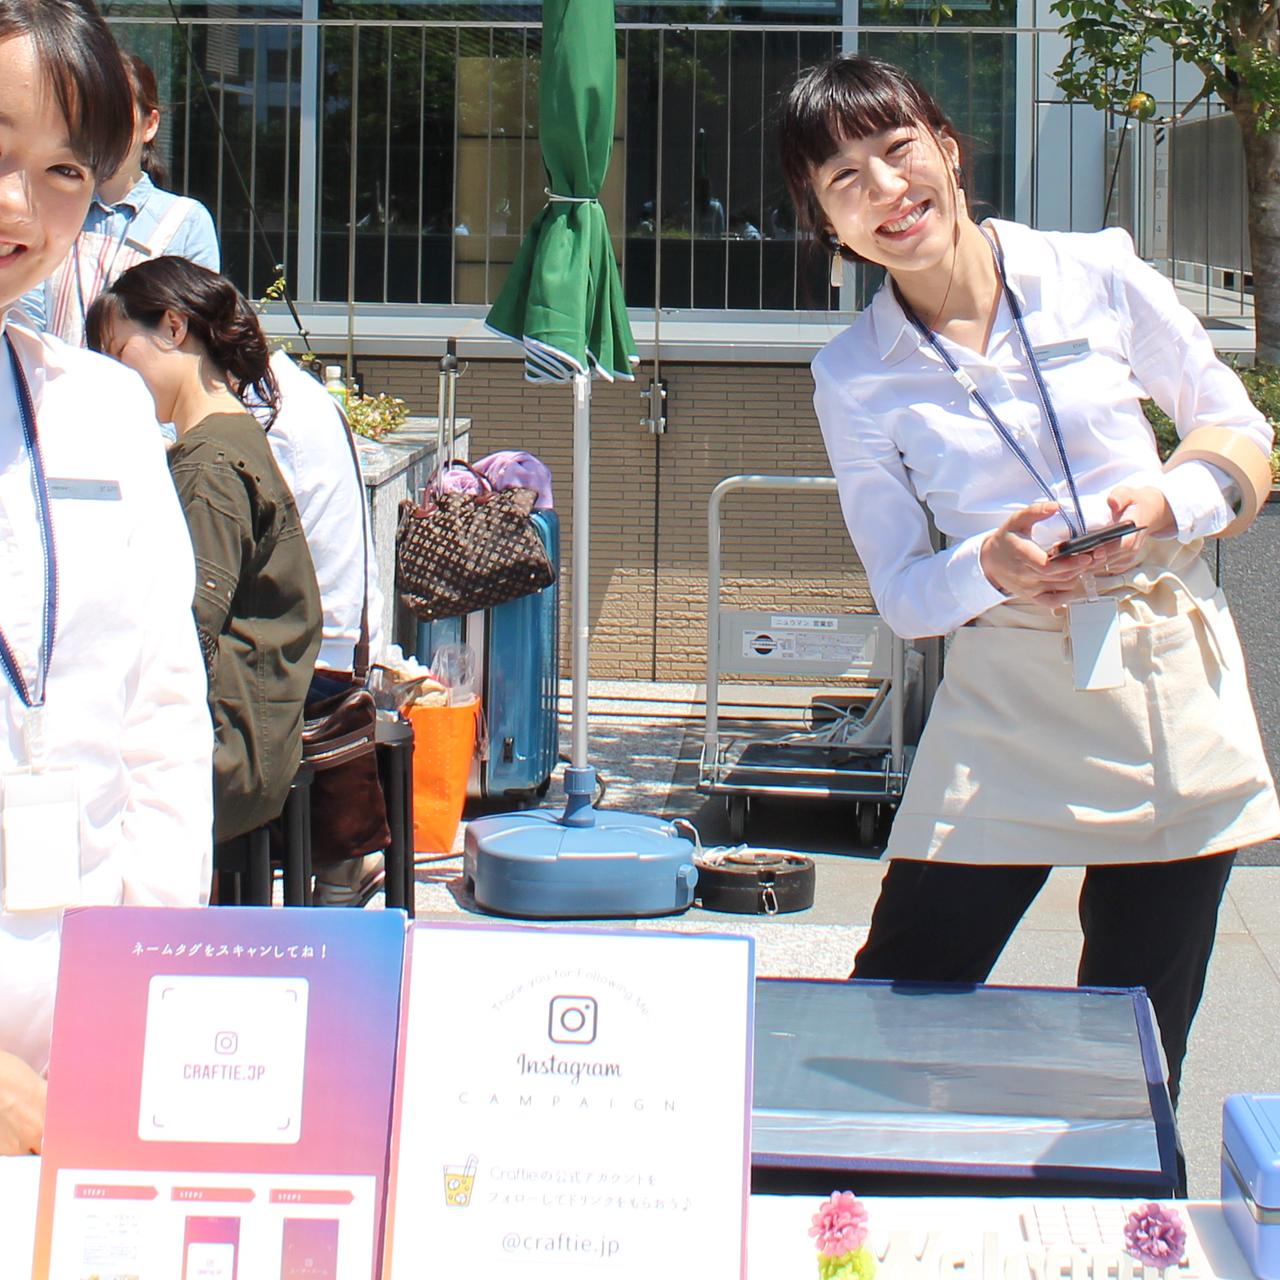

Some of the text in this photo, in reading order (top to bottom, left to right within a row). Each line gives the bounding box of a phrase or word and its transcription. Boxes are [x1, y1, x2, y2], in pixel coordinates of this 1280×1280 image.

[183, 1064, 266, 1081] CRAFTIE.JP
[516, 1053, 622, 1086] Instagram
[501, 1232, 620, 1255] @craftie.jp
